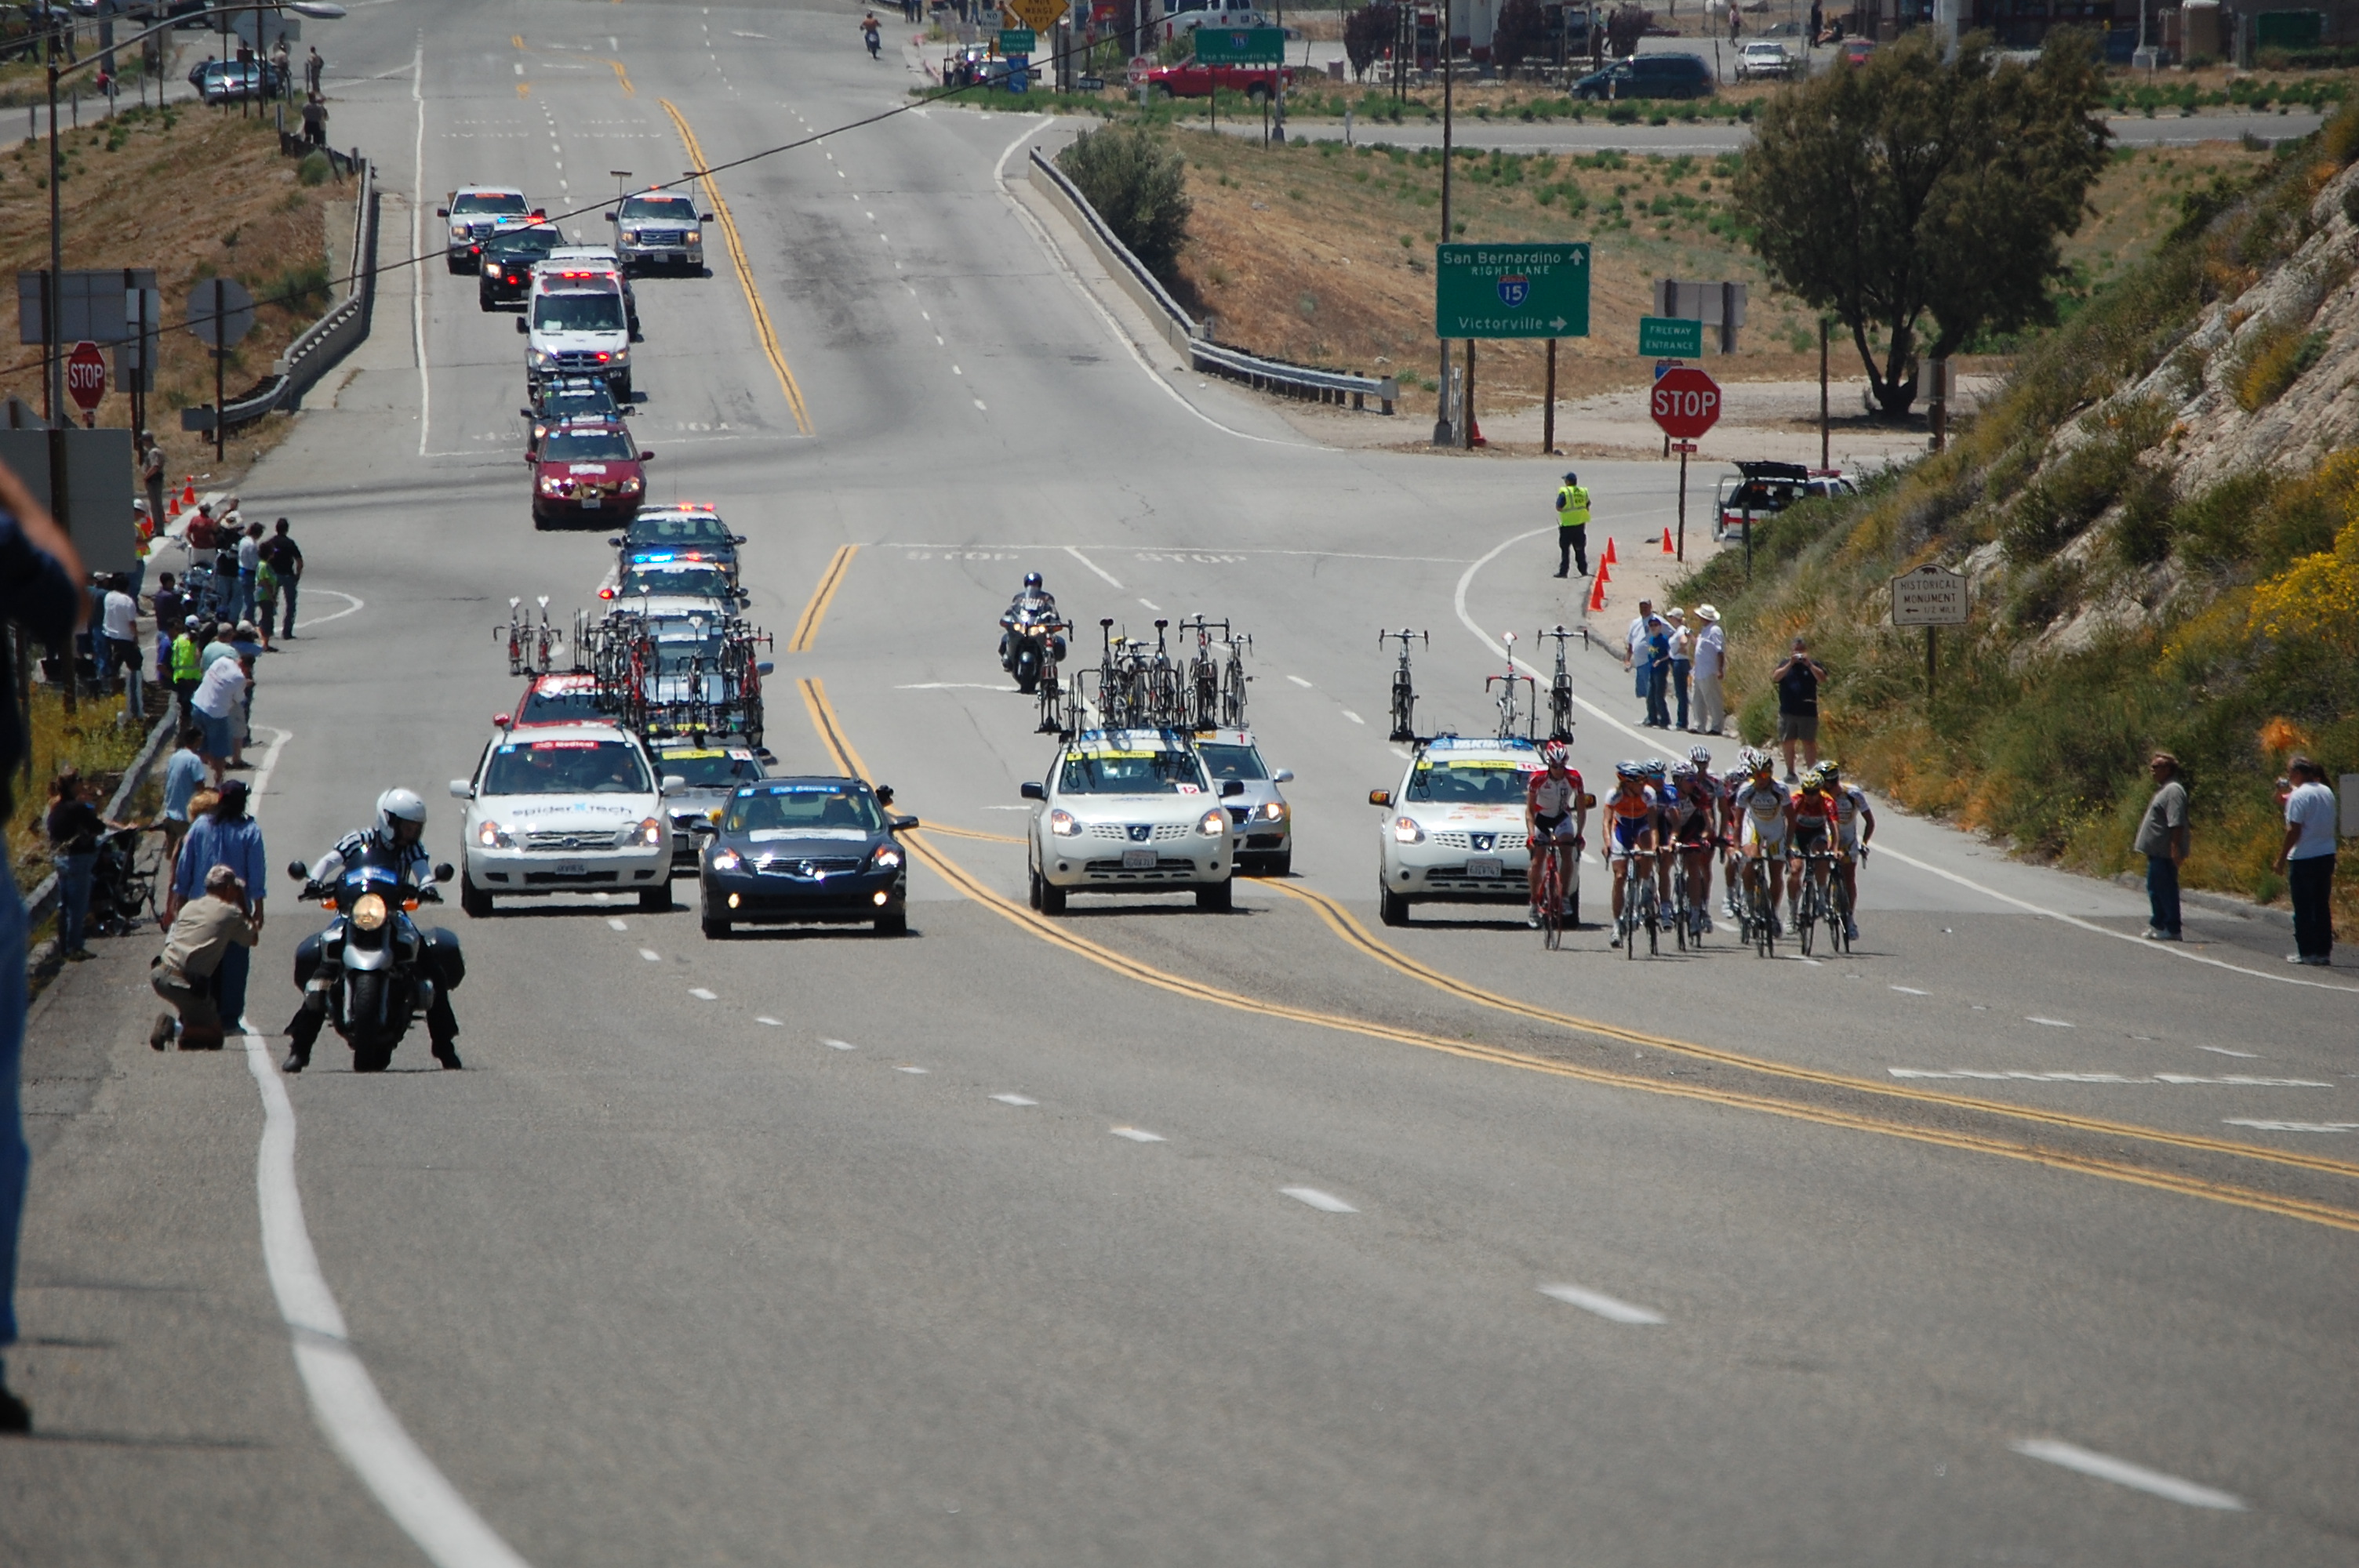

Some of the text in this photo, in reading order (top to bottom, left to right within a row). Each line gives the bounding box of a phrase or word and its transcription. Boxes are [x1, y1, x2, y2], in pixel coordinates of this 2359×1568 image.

[1443, 251, 1561, 264] San Bernardino
[1471, 265, 1550, 276] RIGHT LANE
[1504, 285, 1523, 301] 15
[1459, 316, 1543, 330] Victorville
[1650, 325, 1692, 336] FREEWAY
[1645, 341, 1695, 350] ENTRANCE
[70, 363, 104, 389] STOP
[1655, 390, 1717, 417] STOP
[906, 551, 1019, 561] STOP
[1136, 553, 1247, 563] STOP
[1900, 580, 1958, 590] HISTORICAL
[1904, 593, 1956, 603] MONUMENT
[1181, 786, 1200, 794] 12
[512, 804, 572, 818] spider
